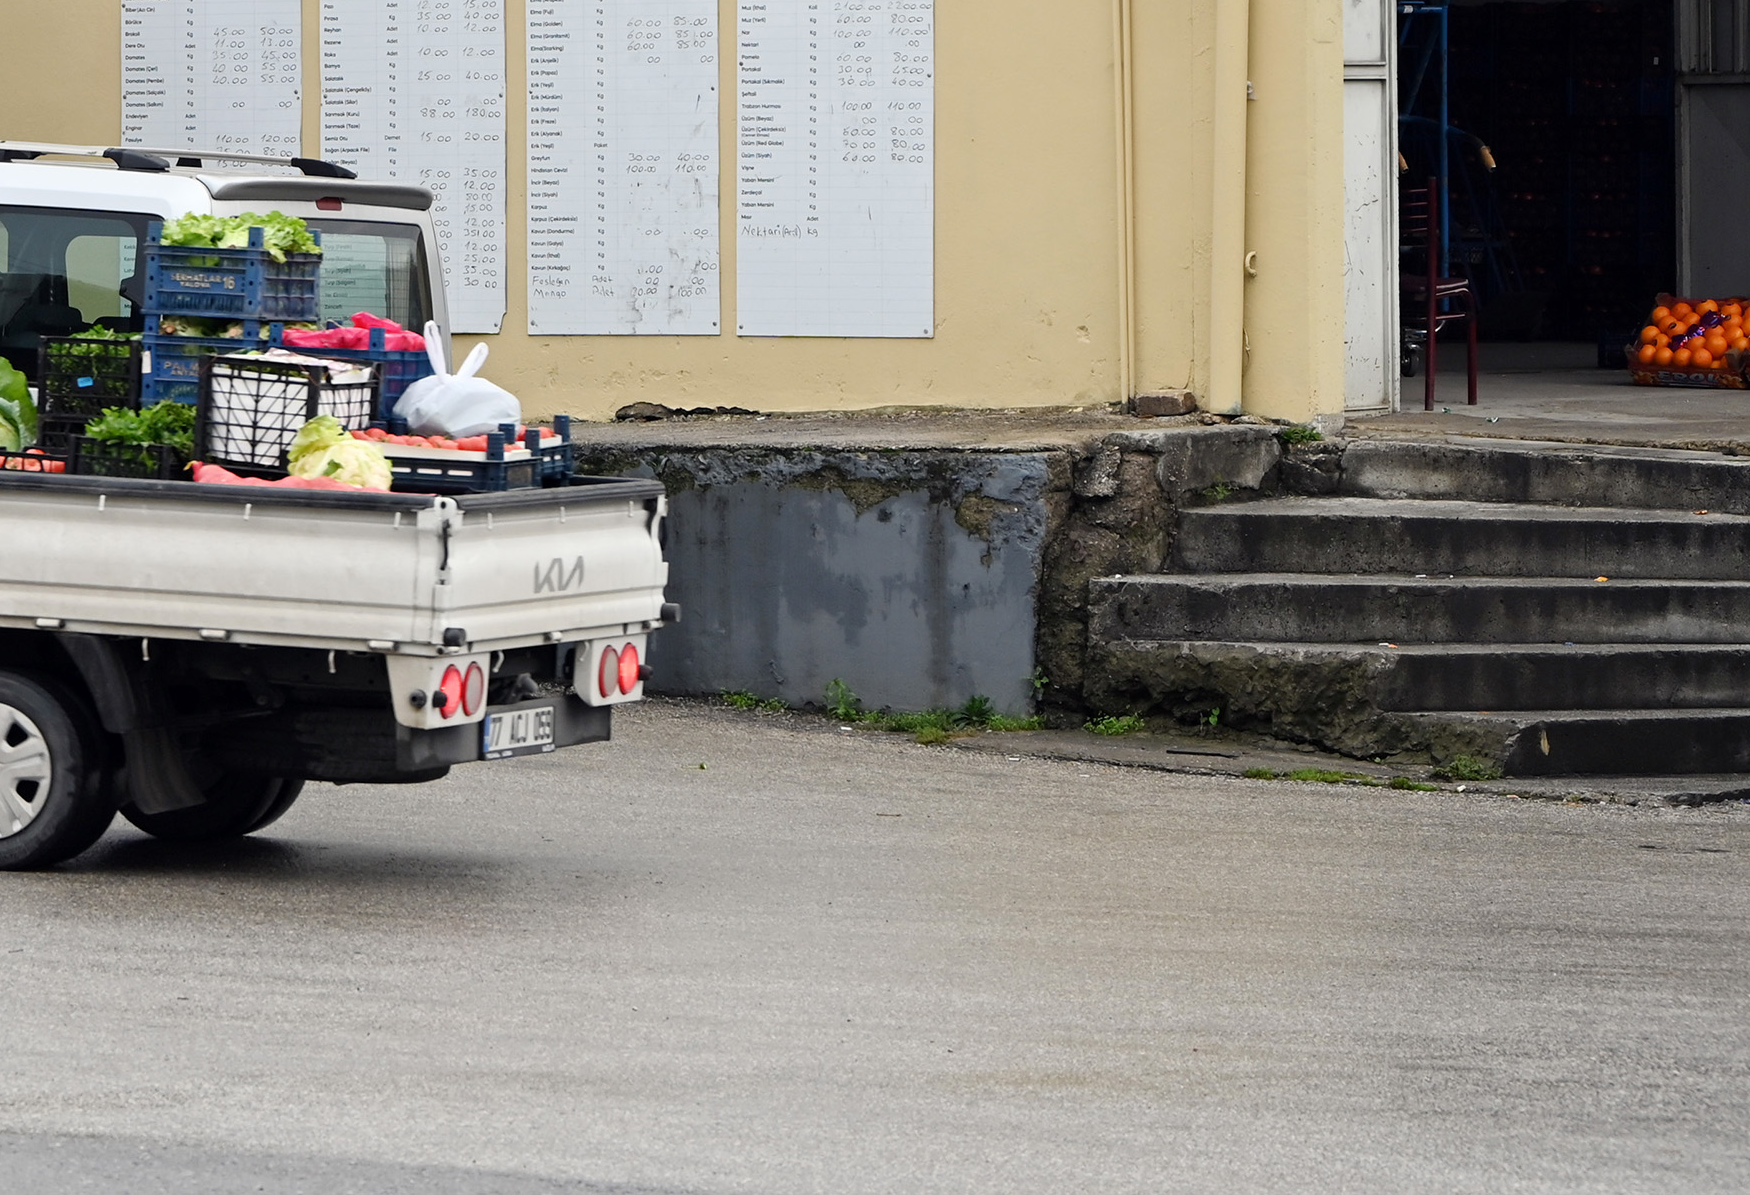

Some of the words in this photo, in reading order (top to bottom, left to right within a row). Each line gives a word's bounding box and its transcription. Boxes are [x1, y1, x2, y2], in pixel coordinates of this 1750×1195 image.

[463, 21, 497, 33] 12.00
[214, 38, 246, 49] 11.00
[260, 37, 294, 48] 13.00
[465, 70, 499, 81] 40.00
[215, 134, 250, 144] 110.00
[260, 133, 297, 144] 120.00
[464, 131, 500, 142] 20.00
[464, 240, 498, 253] 12.00
[463, 253, 496, 264] 25.00
[223, 275, 236, 290] 16
[1657, 371, 1719, 384] EROL
[533, 555, 586, 594] KIA
